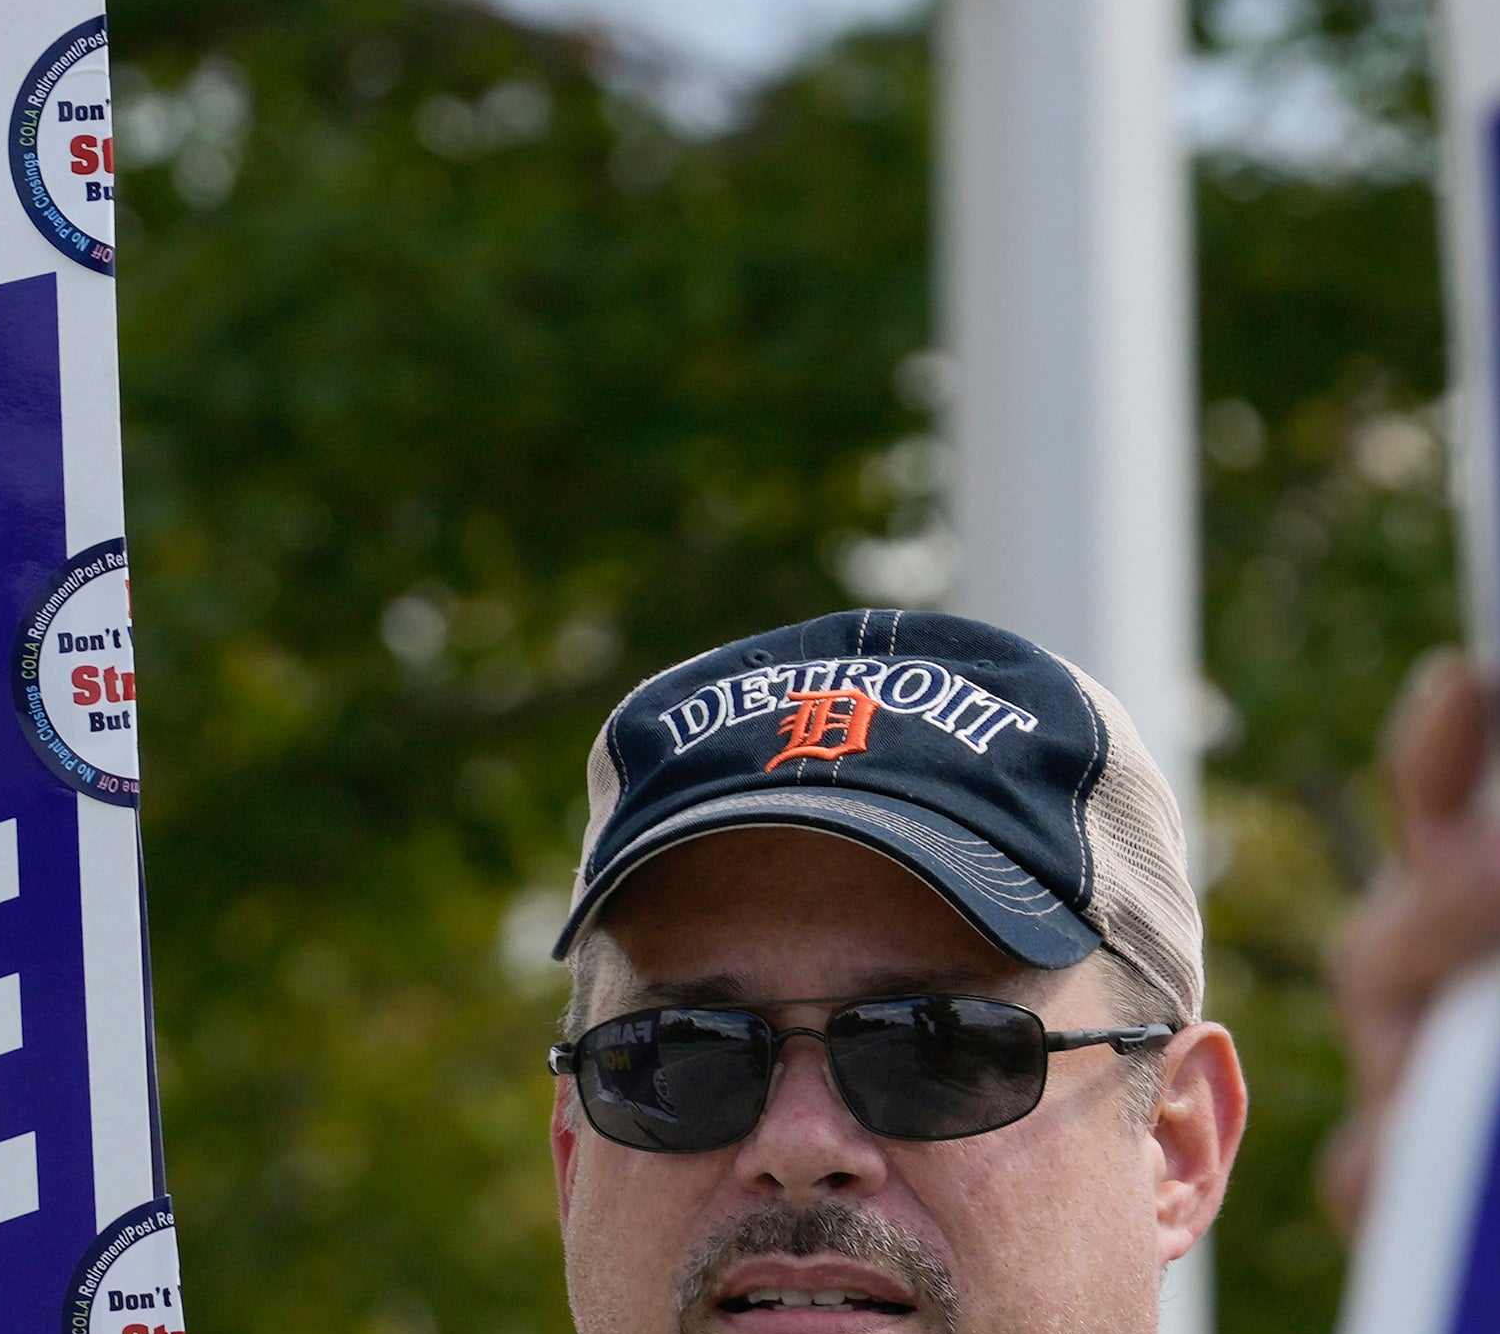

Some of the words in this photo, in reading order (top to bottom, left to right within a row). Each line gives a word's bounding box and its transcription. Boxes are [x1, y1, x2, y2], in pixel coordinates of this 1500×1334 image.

[19, 109, 40, 146] COLA
[42, 206, 73, 240] Plant
[71, 230, 91, 252] No
[57, 627, 121, 654] Don't
[21, 642, 40, 679] COLA
[26, 685, 54, 741] Closings
[88, 710, 131, 733] But
[658, 659, 1038, 755] DETROIT
[47, 738, 79, 771] Plant
[77, 763, 96, 784] No
[108, 1286, 172, 1312] Don't
